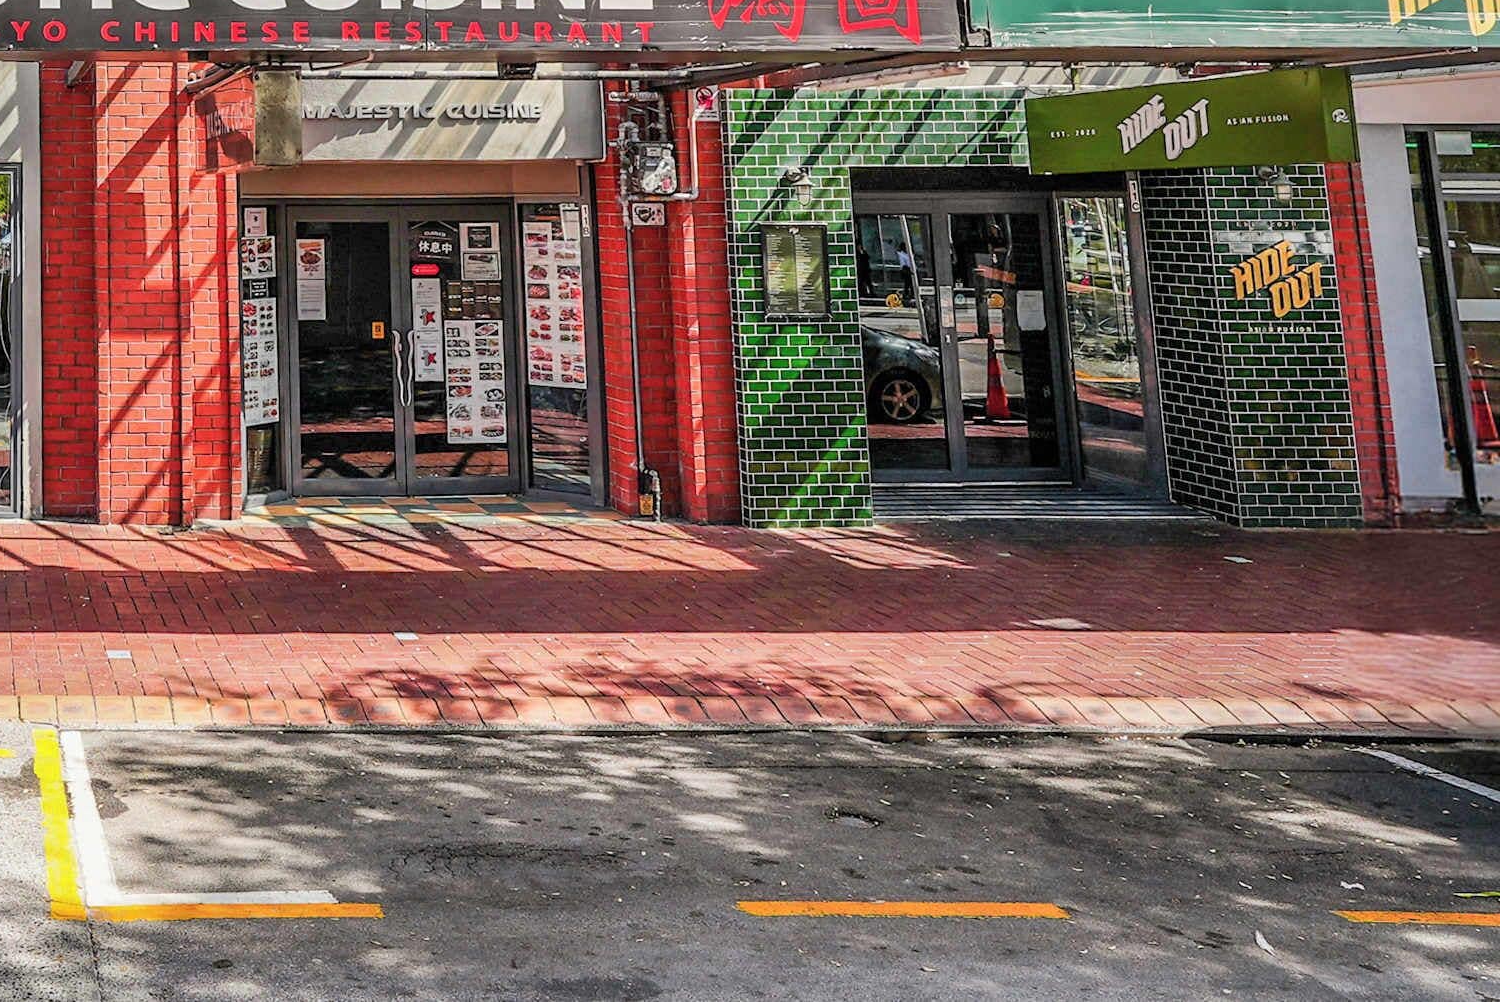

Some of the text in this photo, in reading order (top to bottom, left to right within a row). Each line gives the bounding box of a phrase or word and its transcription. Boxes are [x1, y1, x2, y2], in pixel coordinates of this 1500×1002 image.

[100, 19, 311, 44] CHINESE
[341, 20, 655, 45] RESTAURANT
[301, 102, 542, 119] MAJESTIC CUISINE
[1117, 94, 1166, 155] HIDE
[1163, 99, 1210, 161] OUT
[1255, 114, 1290, 124] FUSION
[418, 240, 453, 255] 休息中
[1229, 240, 1297, 300] HIDE
[1269, 262, 1323, 318] OUT
